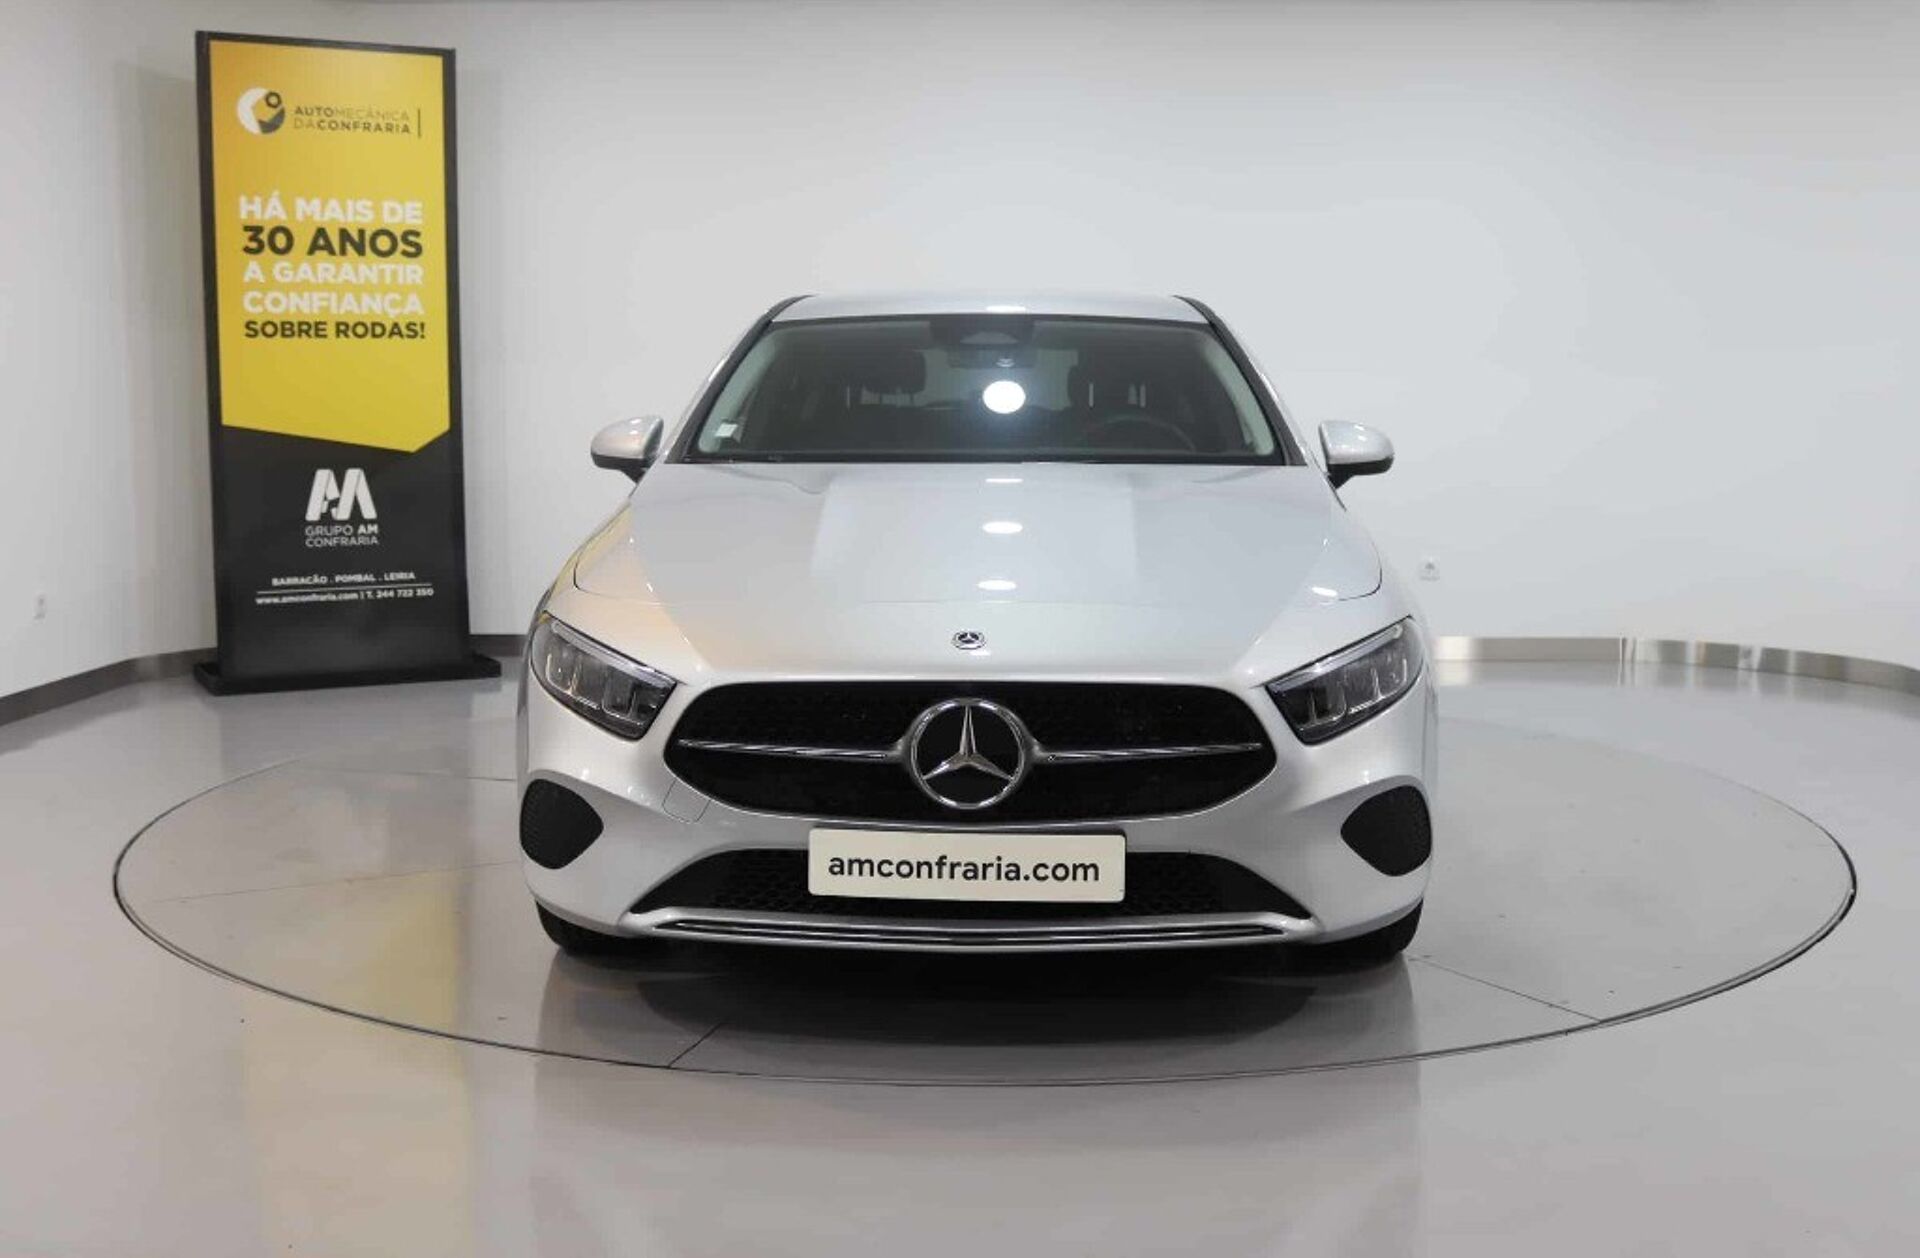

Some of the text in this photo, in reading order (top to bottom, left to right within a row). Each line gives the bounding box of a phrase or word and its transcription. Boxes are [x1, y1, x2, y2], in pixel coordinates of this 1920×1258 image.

[239, 190, 423, 224] HÁ MAIS DE
[242, 225, 423, 258] 30 ANOS
[243, 261, 423, 285] A GARANTIR
[242, 291, 425, 318] CONFIANÇA
[244, 320, 425, 339] SOBRE RODAS!
[305, 523, 378, 537] GRUPO AM
[305, 536, 379, 547] CONFRARIA
[335, 573, 376, 583] POMBAL
[383, 571, 416, 581] LEIRIA
[828, 855, 1100, 882] amconfraria.com
